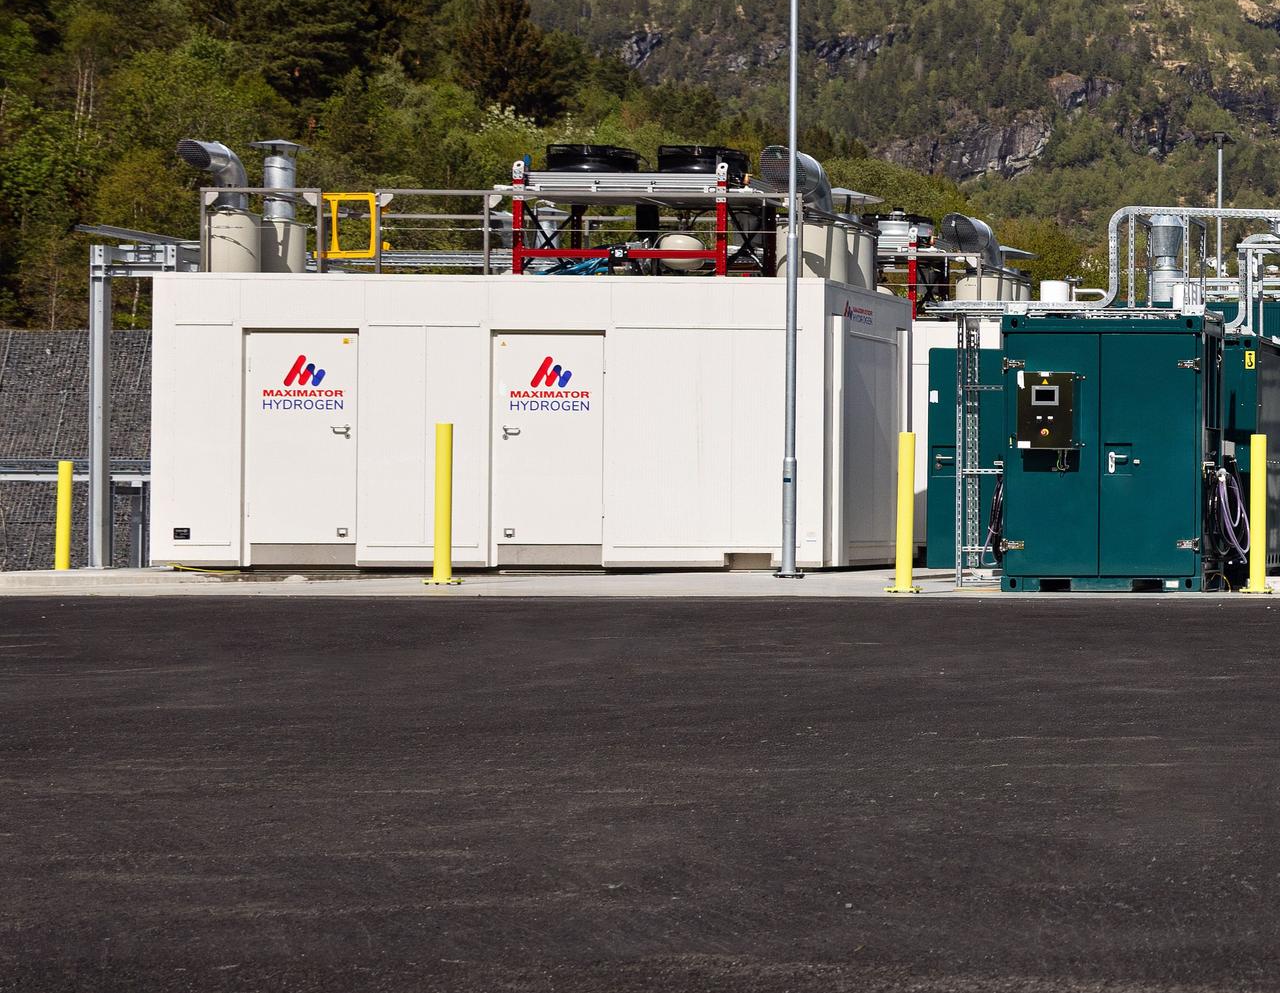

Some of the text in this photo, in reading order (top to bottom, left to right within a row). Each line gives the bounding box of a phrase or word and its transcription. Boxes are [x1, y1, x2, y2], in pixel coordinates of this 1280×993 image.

[263, 389, 344, 397] MAXIMATOR
[262, 399, 344, 410] HYDROGEN
[510, 400, 590, 411] HYDROGEN
